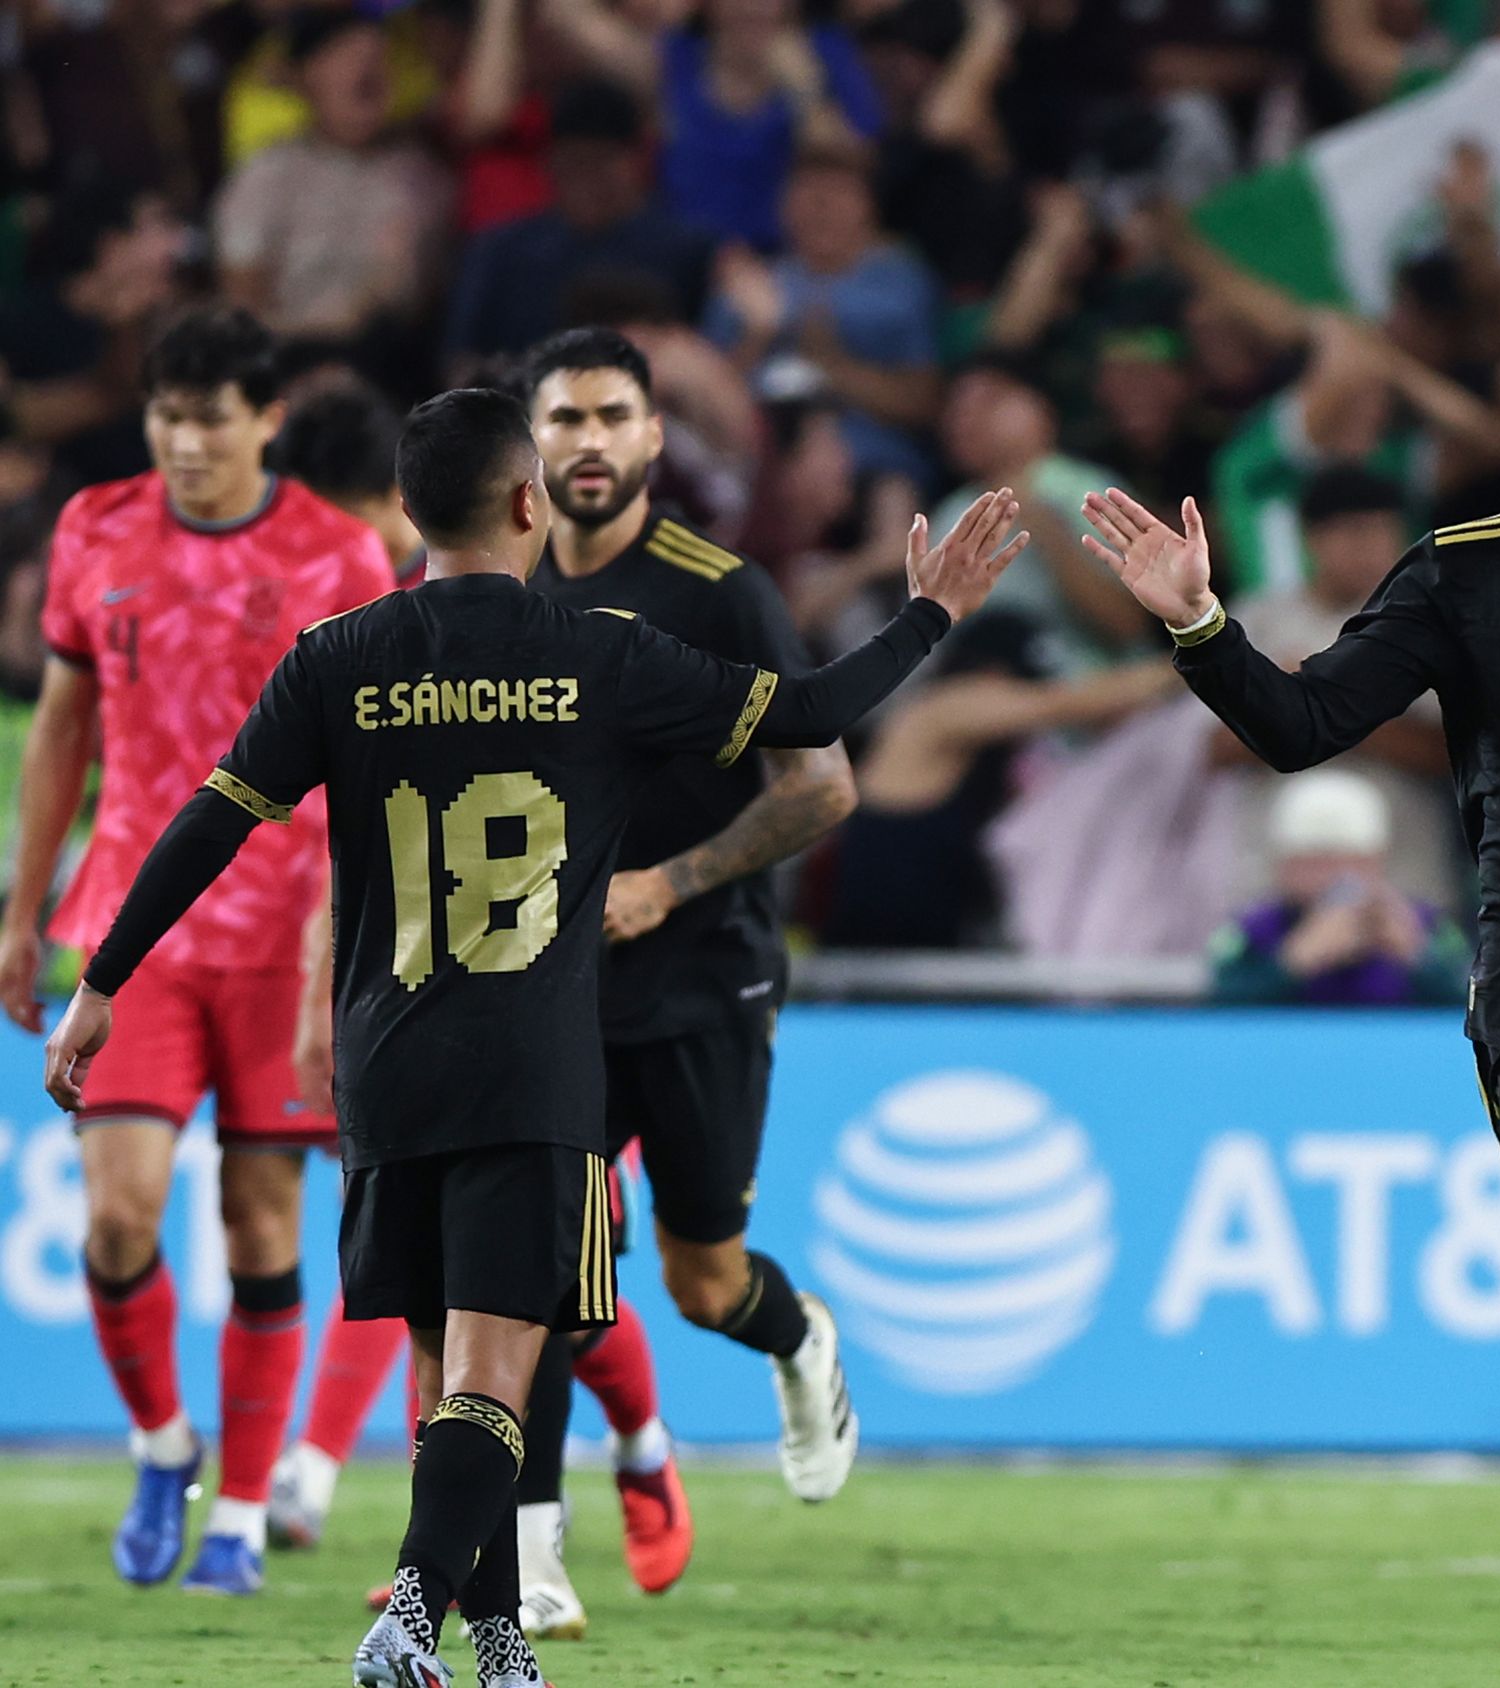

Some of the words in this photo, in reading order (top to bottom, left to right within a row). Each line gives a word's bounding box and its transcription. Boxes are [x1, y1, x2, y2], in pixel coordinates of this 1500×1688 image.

[109, 613, 139, 683] 4
[354, 672, 580, 730] E.SÁNCHEZ
[384, 771, 568, 992] 18
